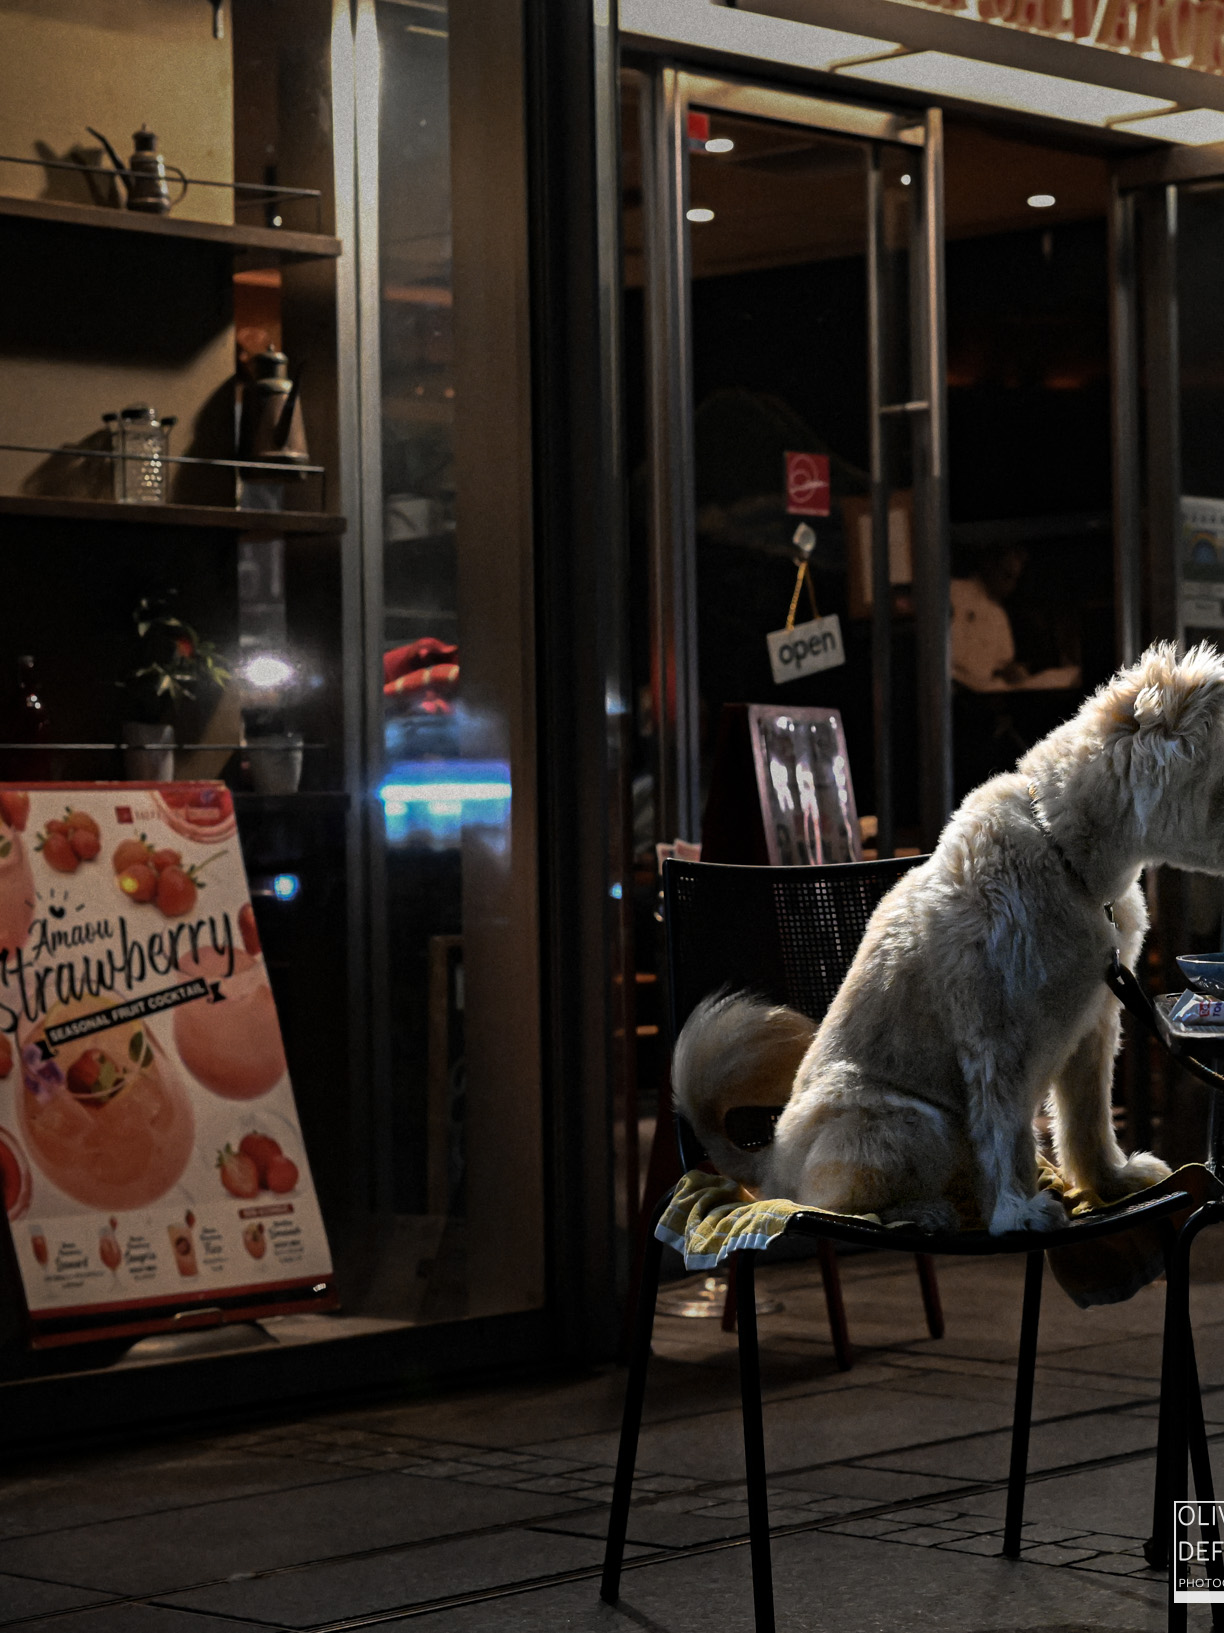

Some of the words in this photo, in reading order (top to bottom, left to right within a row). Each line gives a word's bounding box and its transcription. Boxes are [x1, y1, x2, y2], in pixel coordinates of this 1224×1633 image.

[778, 631, 836, 668] open
[50, 1013, 110, 1042] SEASONAL
[111, 1002, 147, 1022] FRUIT
[147, 982, 205, 1010] COCKTAIL
